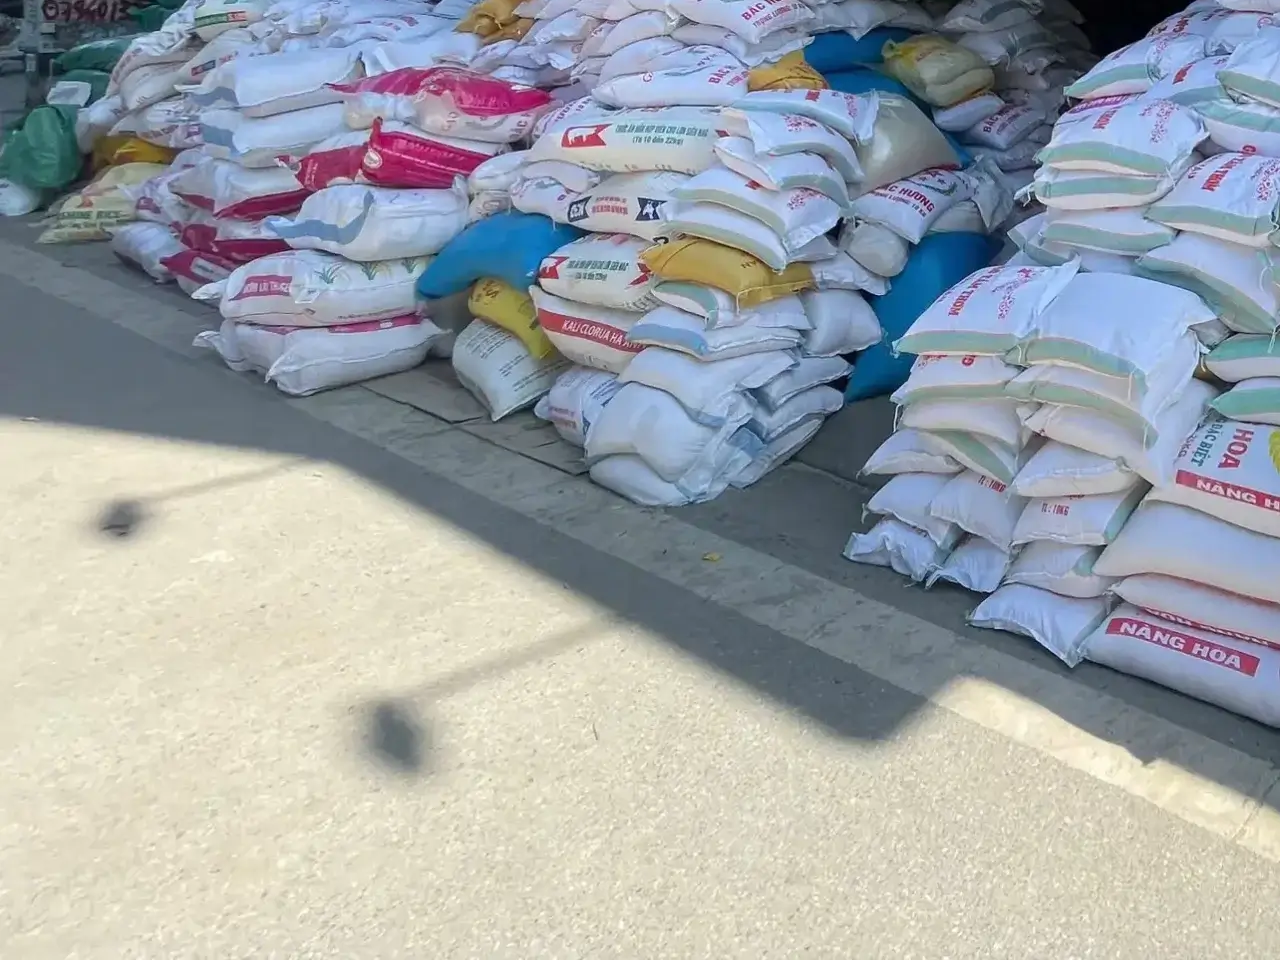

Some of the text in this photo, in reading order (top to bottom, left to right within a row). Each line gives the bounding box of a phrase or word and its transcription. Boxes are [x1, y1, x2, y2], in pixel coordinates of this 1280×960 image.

[561, 319, 580, 333] KALI
[579, 323, 610, 341] CLORUA
[1190, 442, 1214, 468] BIỆT
[1217, 428, 1255, 470] HOA
[1196, 478, 1257, 504] NÀNG
[1119, 621, 1185, 651] NÀNG
[1191, 646, 1243, 670] HOA
